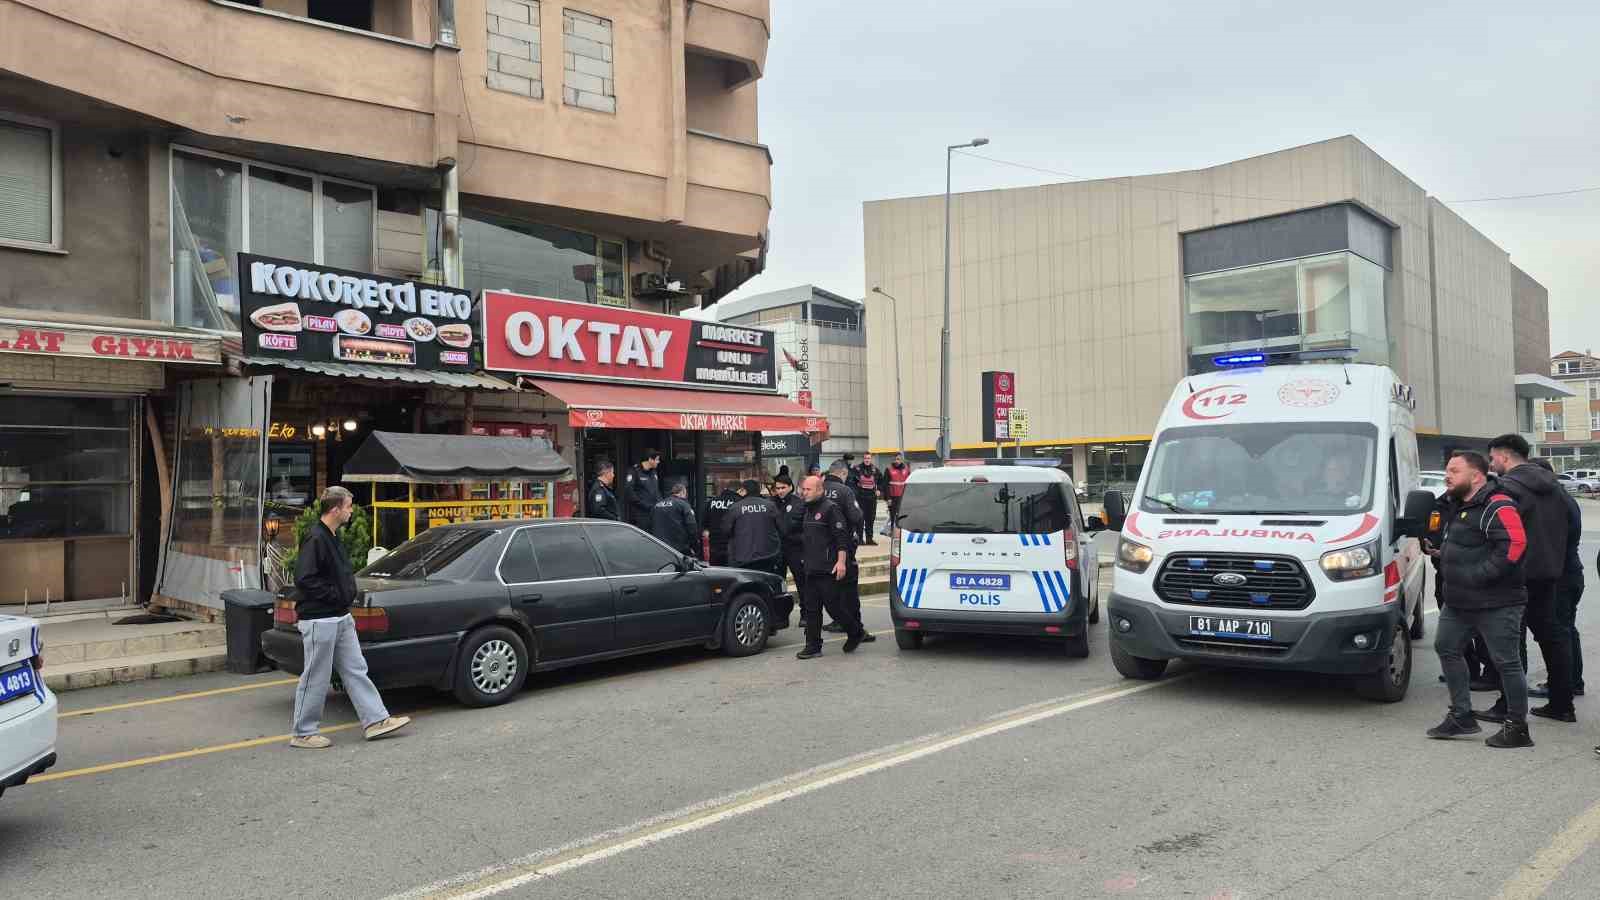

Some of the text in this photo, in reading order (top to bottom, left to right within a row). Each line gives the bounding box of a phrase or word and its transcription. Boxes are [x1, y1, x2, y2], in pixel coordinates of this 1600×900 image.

[420, 288, 472, 320] EKO
[505, 311, 673, 369] OKTAY
[701, 325, 764, 346] MARKET
[1199, 394, 1248, 408] 112
[680, 414, 747, 432] OKTAY MARKET
[956, 577, 966, 585] 81
[968, 577, 977, 585] A
[960, 592, 1001, 606] POLİS
[1198, 618, 1269, 635] 81 AAP 710
[7, 671, 31, 692] 4813
